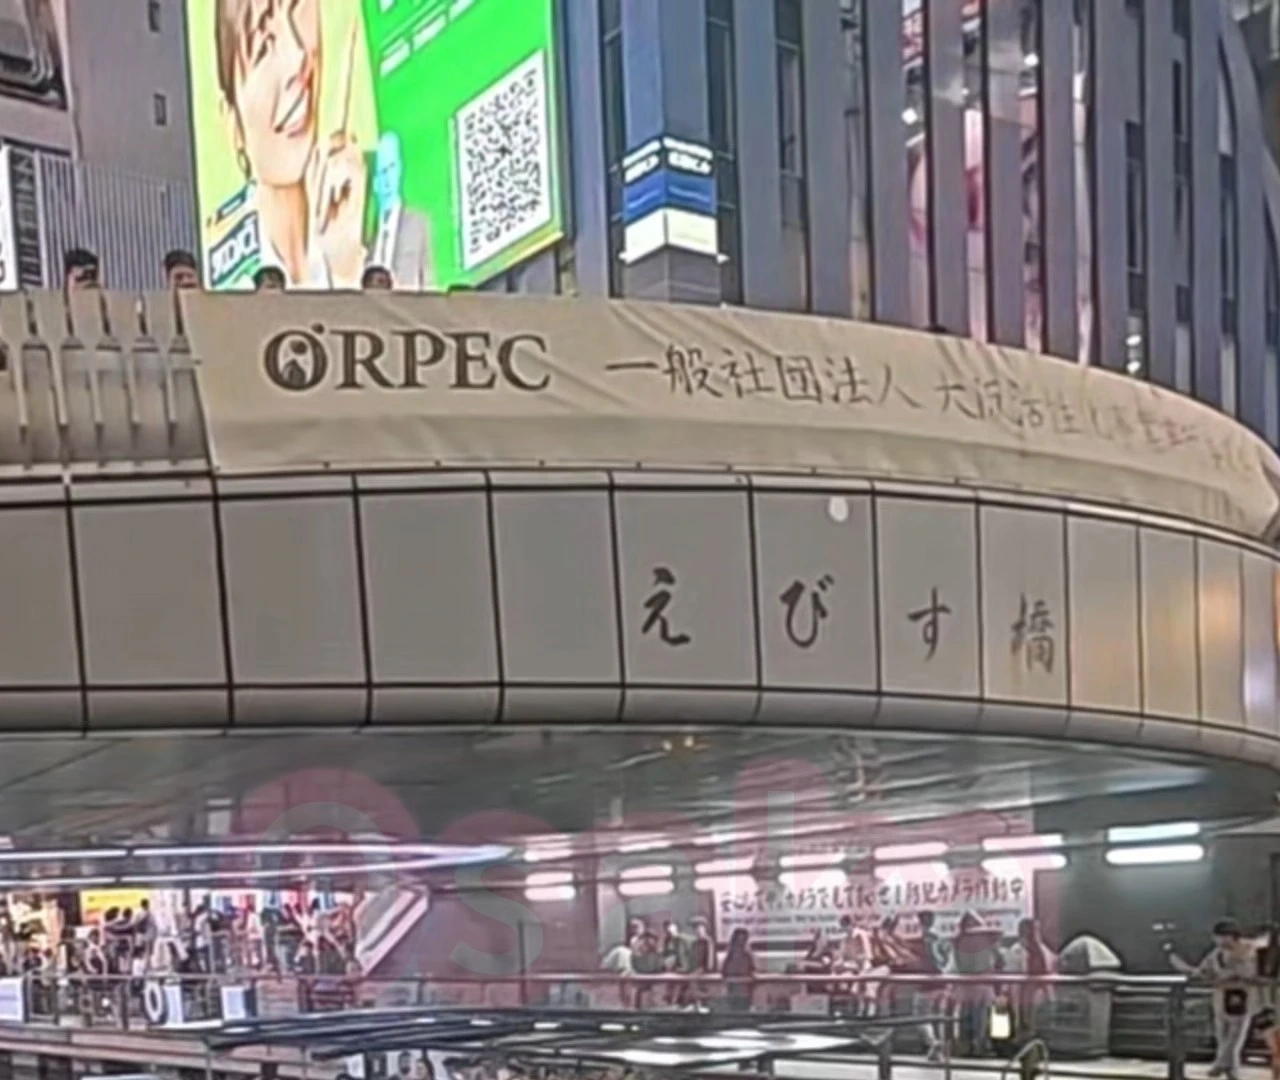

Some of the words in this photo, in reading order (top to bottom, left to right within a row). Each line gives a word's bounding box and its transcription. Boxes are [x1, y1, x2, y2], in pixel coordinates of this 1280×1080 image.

[263, 321, 551, 394] ORPEC
[604, 343, 923, 412] 一般社団法人
[638, 567, 1057, 675] えびす橋
